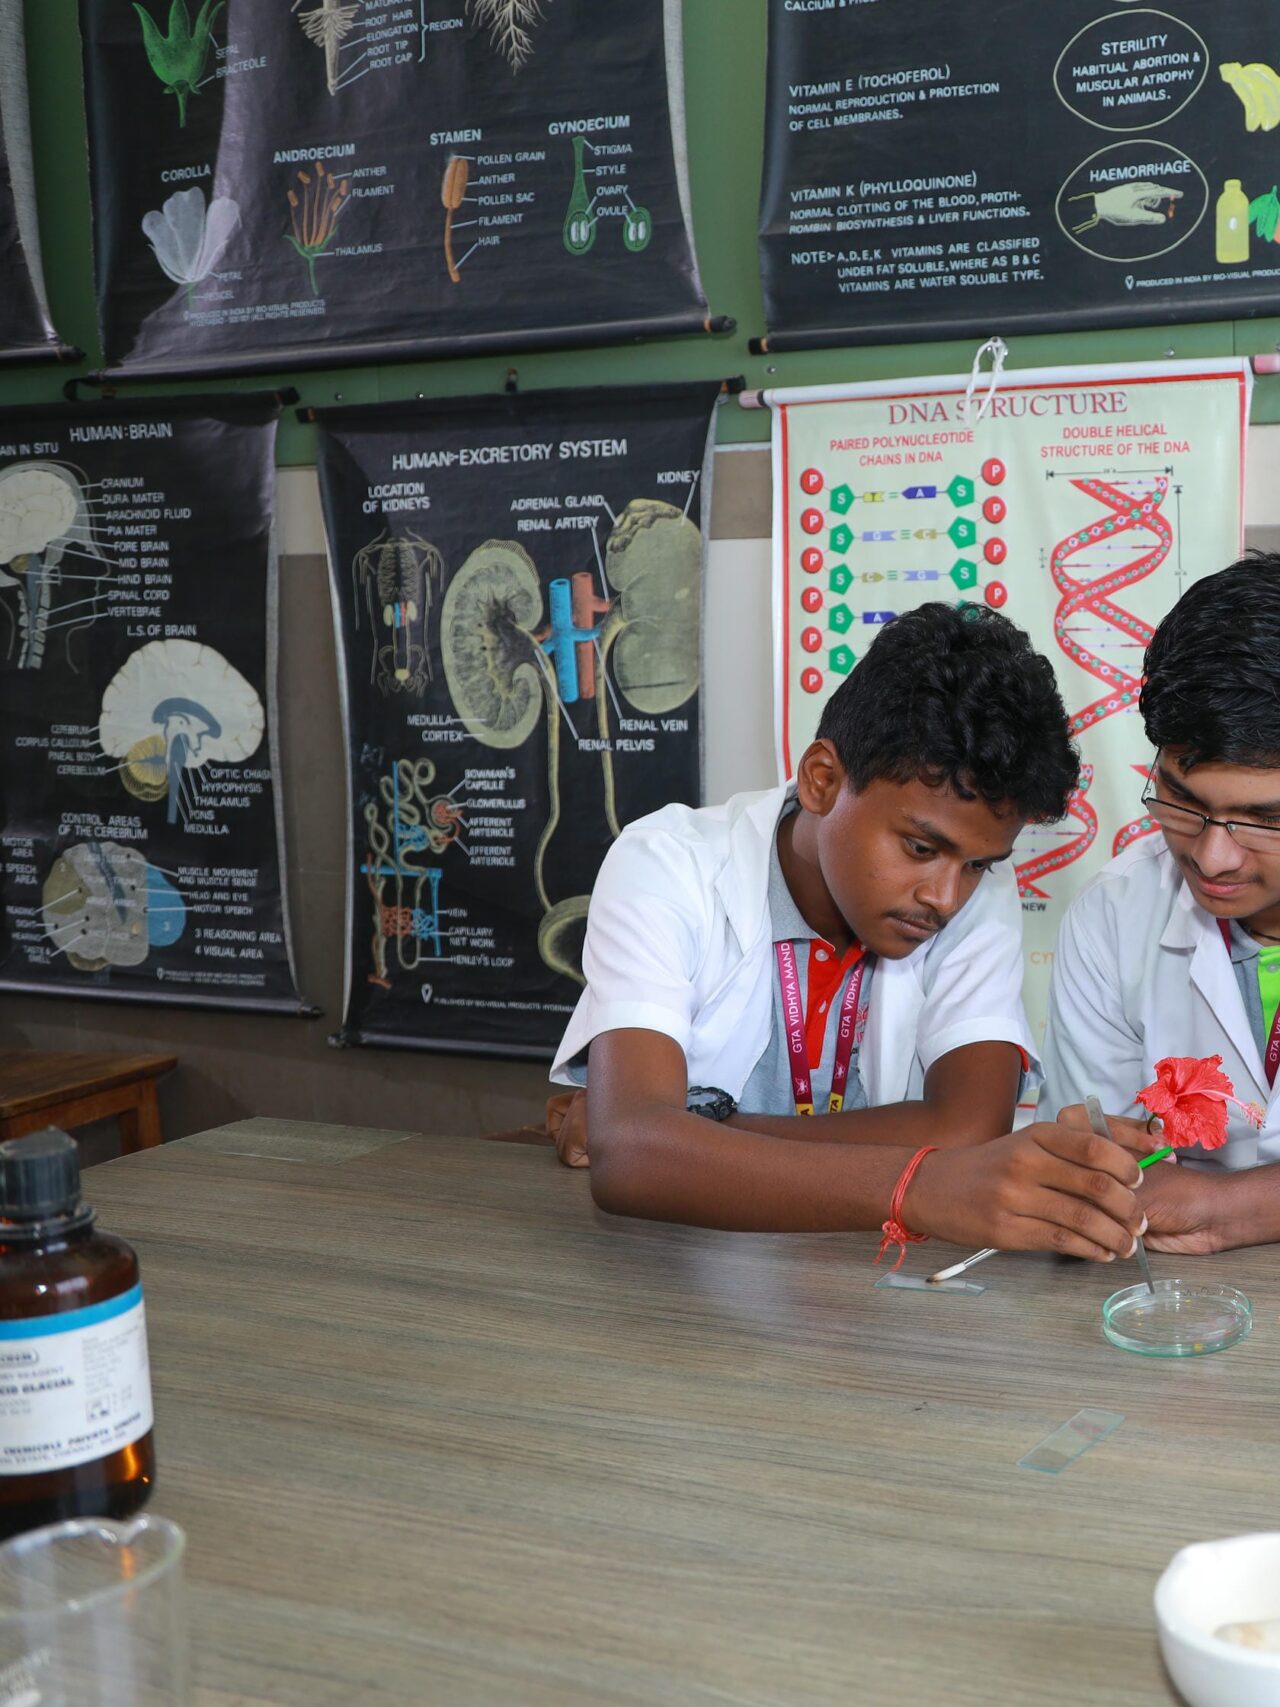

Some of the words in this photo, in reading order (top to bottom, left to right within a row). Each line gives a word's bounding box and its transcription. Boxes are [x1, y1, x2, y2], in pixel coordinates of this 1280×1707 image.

[366, 23, 418, 41] ELONGATION
[429, 19, 463, 31] REGION
[1101, 34, 1168, 56] STERILITY
[370, 57, 392, 69] ROOT
[395, 52, 412, 64] CAP
[1073, 61, 1128, 76] HABITUAL
[1134, 54, 1189, 71] ABORTION
[1192, 52, 1200, 62] &
[790, 81, 840, 98] VITAMIN
[846, 80, 852, 91] E
[858, 64, 950, 90] (TOCHOFEROL)
[1076, 76, 1138, 92] MUSCULAR
[1142, 70, 1194, 86] ATROPHY
[788, 102, 832, 115] NORMAL
[836, 92, 915, 111] REPRODUCTION
[919, 90, 926, 100] &
[930, 83, 999, 98] PROTECTION
[1102, 96, 1114, 107] IN
[1117, 90, 1171, 106] ANIMALS.
[548, 116, 630, 135] GYNOECIUM
[789, 120, 804, 131] OF
[808, 118, 830, 130] CELL
[834, 109, 904, 126] MEMBRANES.
[430, 129, 481, 145] STAMEN
[274, 144, 355, 164] ANDROECIUM
[477, 154, 512, 166] POLLEN
[516, 152, 545, 162] GRAIN
[594, 144, 632, 156] STIGMA
[161, 164, 211, 183] COROLLA
[596, 164, 626, 175] STYLE
[1089, 160, 1191, 182] HAEMORRHAGE
[791, 186, 840, 202] VITAMIN
[846, 185, 854, 196] K
[860, 170, 976, 197] (PHYLLOQUINONE)
[596, 206, 628, 217] OVULE
[790, 208, 834, 220] NORMAL
[837, 203, 890, 217] CLOTTING
[894, 201, 908, 210] OF
[912, 198, 933, 210] THE
[478, 214, 523, 226] FILAMENT
[892, 245, 942, 258] VITAMINS
[948, 243, 969, 254] ARE
[976, 237, 1039, 252] CLASSIFIED
[889, 402, 949, 424] DNA
[1063, 425, 1112, 440] DOUBLE
[1116, 422, 1167, 438] HELICAL
[559, 439, 627, 458] SYSTEM
[830, 437, 869, 451] PAIRED
[872, 430, 974, 449] POLYNUCLEOTIDE
[1040, 442, 1113, 458] STRUCTURE
[1117, 443, 1133, 456] OF
[1137, 442, 1160, 456] THE
[1164, 440, 1190, 454] DNA
[860, 452, 901, 466] CHAINS
[904, 453, 916, 463] IN
[918, 452, 942, 463] DNA
[101, 478, 143, 488] CRANIUM
[657, 470, 700, 483] KIDNEY
[368, 483, 424, 497] LOCATION
[363, 500, 378, 513] OF
[381, 496, 430, 511] KIDNEYS
[511, 498, 561, 511] ADRENAL
[565, 494, 604, 507] GLAND
[517, 518, 552, 531] RENAL
[555, 516, 599, 529] ARTERY
[108, 591, 140, 600] SPINAL
[108, 607, 161, 616] VERTEBRAE
[147, 626, 161, 635] OF
[165, 625, 196, 636] BRAIN
[194, 796, 250, 807] THALAMUS
[1022, 903, 1046, 912] NEW
[844, 968, 860, 1010] VIDHYA
[786, 982, 799, 1026] VIDHYA
[841, 1015, 851, 1038] GTA
[792, 1030, 802, 1053] GTA
[1270, 1039, 1280, 1062] GTA
